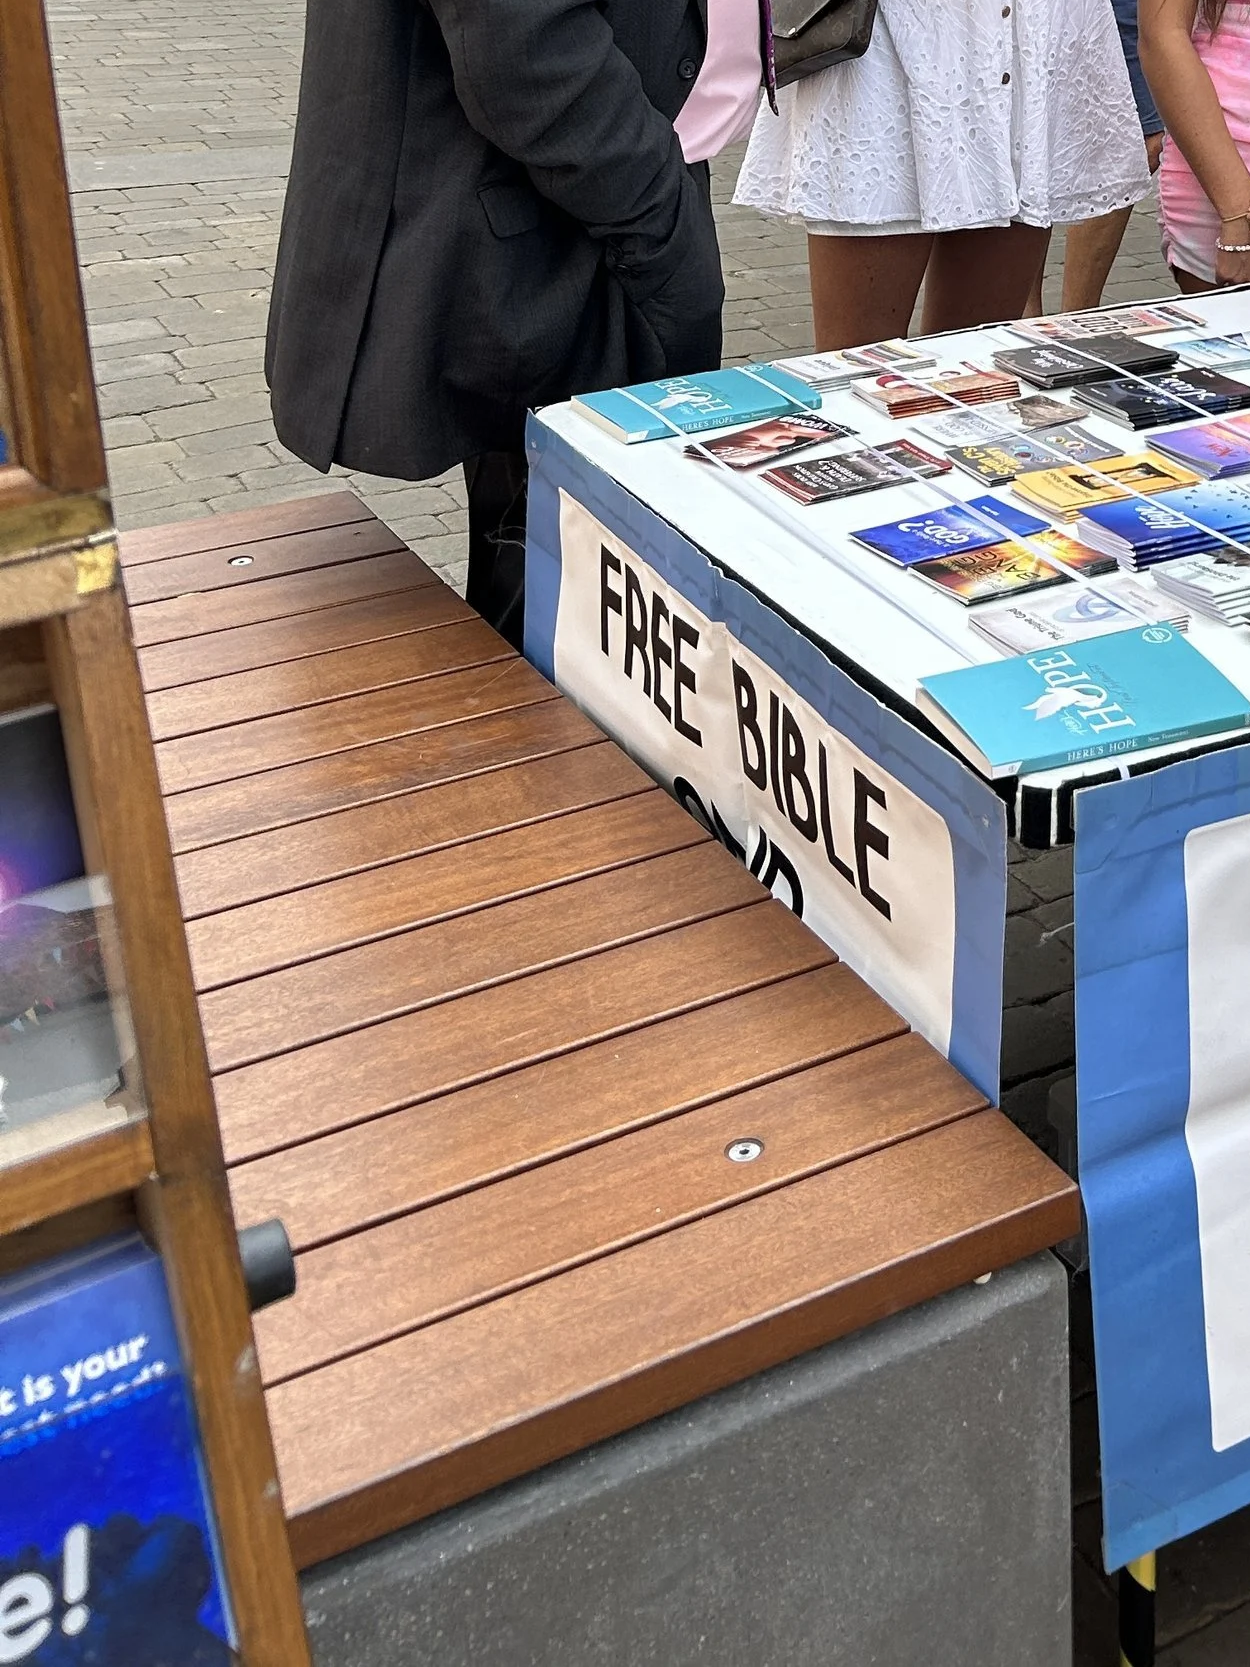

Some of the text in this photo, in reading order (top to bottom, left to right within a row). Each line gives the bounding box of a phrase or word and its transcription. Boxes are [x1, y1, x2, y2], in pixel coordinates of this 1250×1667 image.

[655, 378, 732, 415] HOPE
[898, 519, 970, 544] GOD?
[972, 551, 1041, 580] BANG
[1028, 651, 1136, 734] HOPE
[600, 542, 892, 922] FREE BIBLE
[1067, 744, 1104, 761] HERE'S
[1109, 738, 1138, 753] HOPE
[22, 1333, 150, 1407] is your
